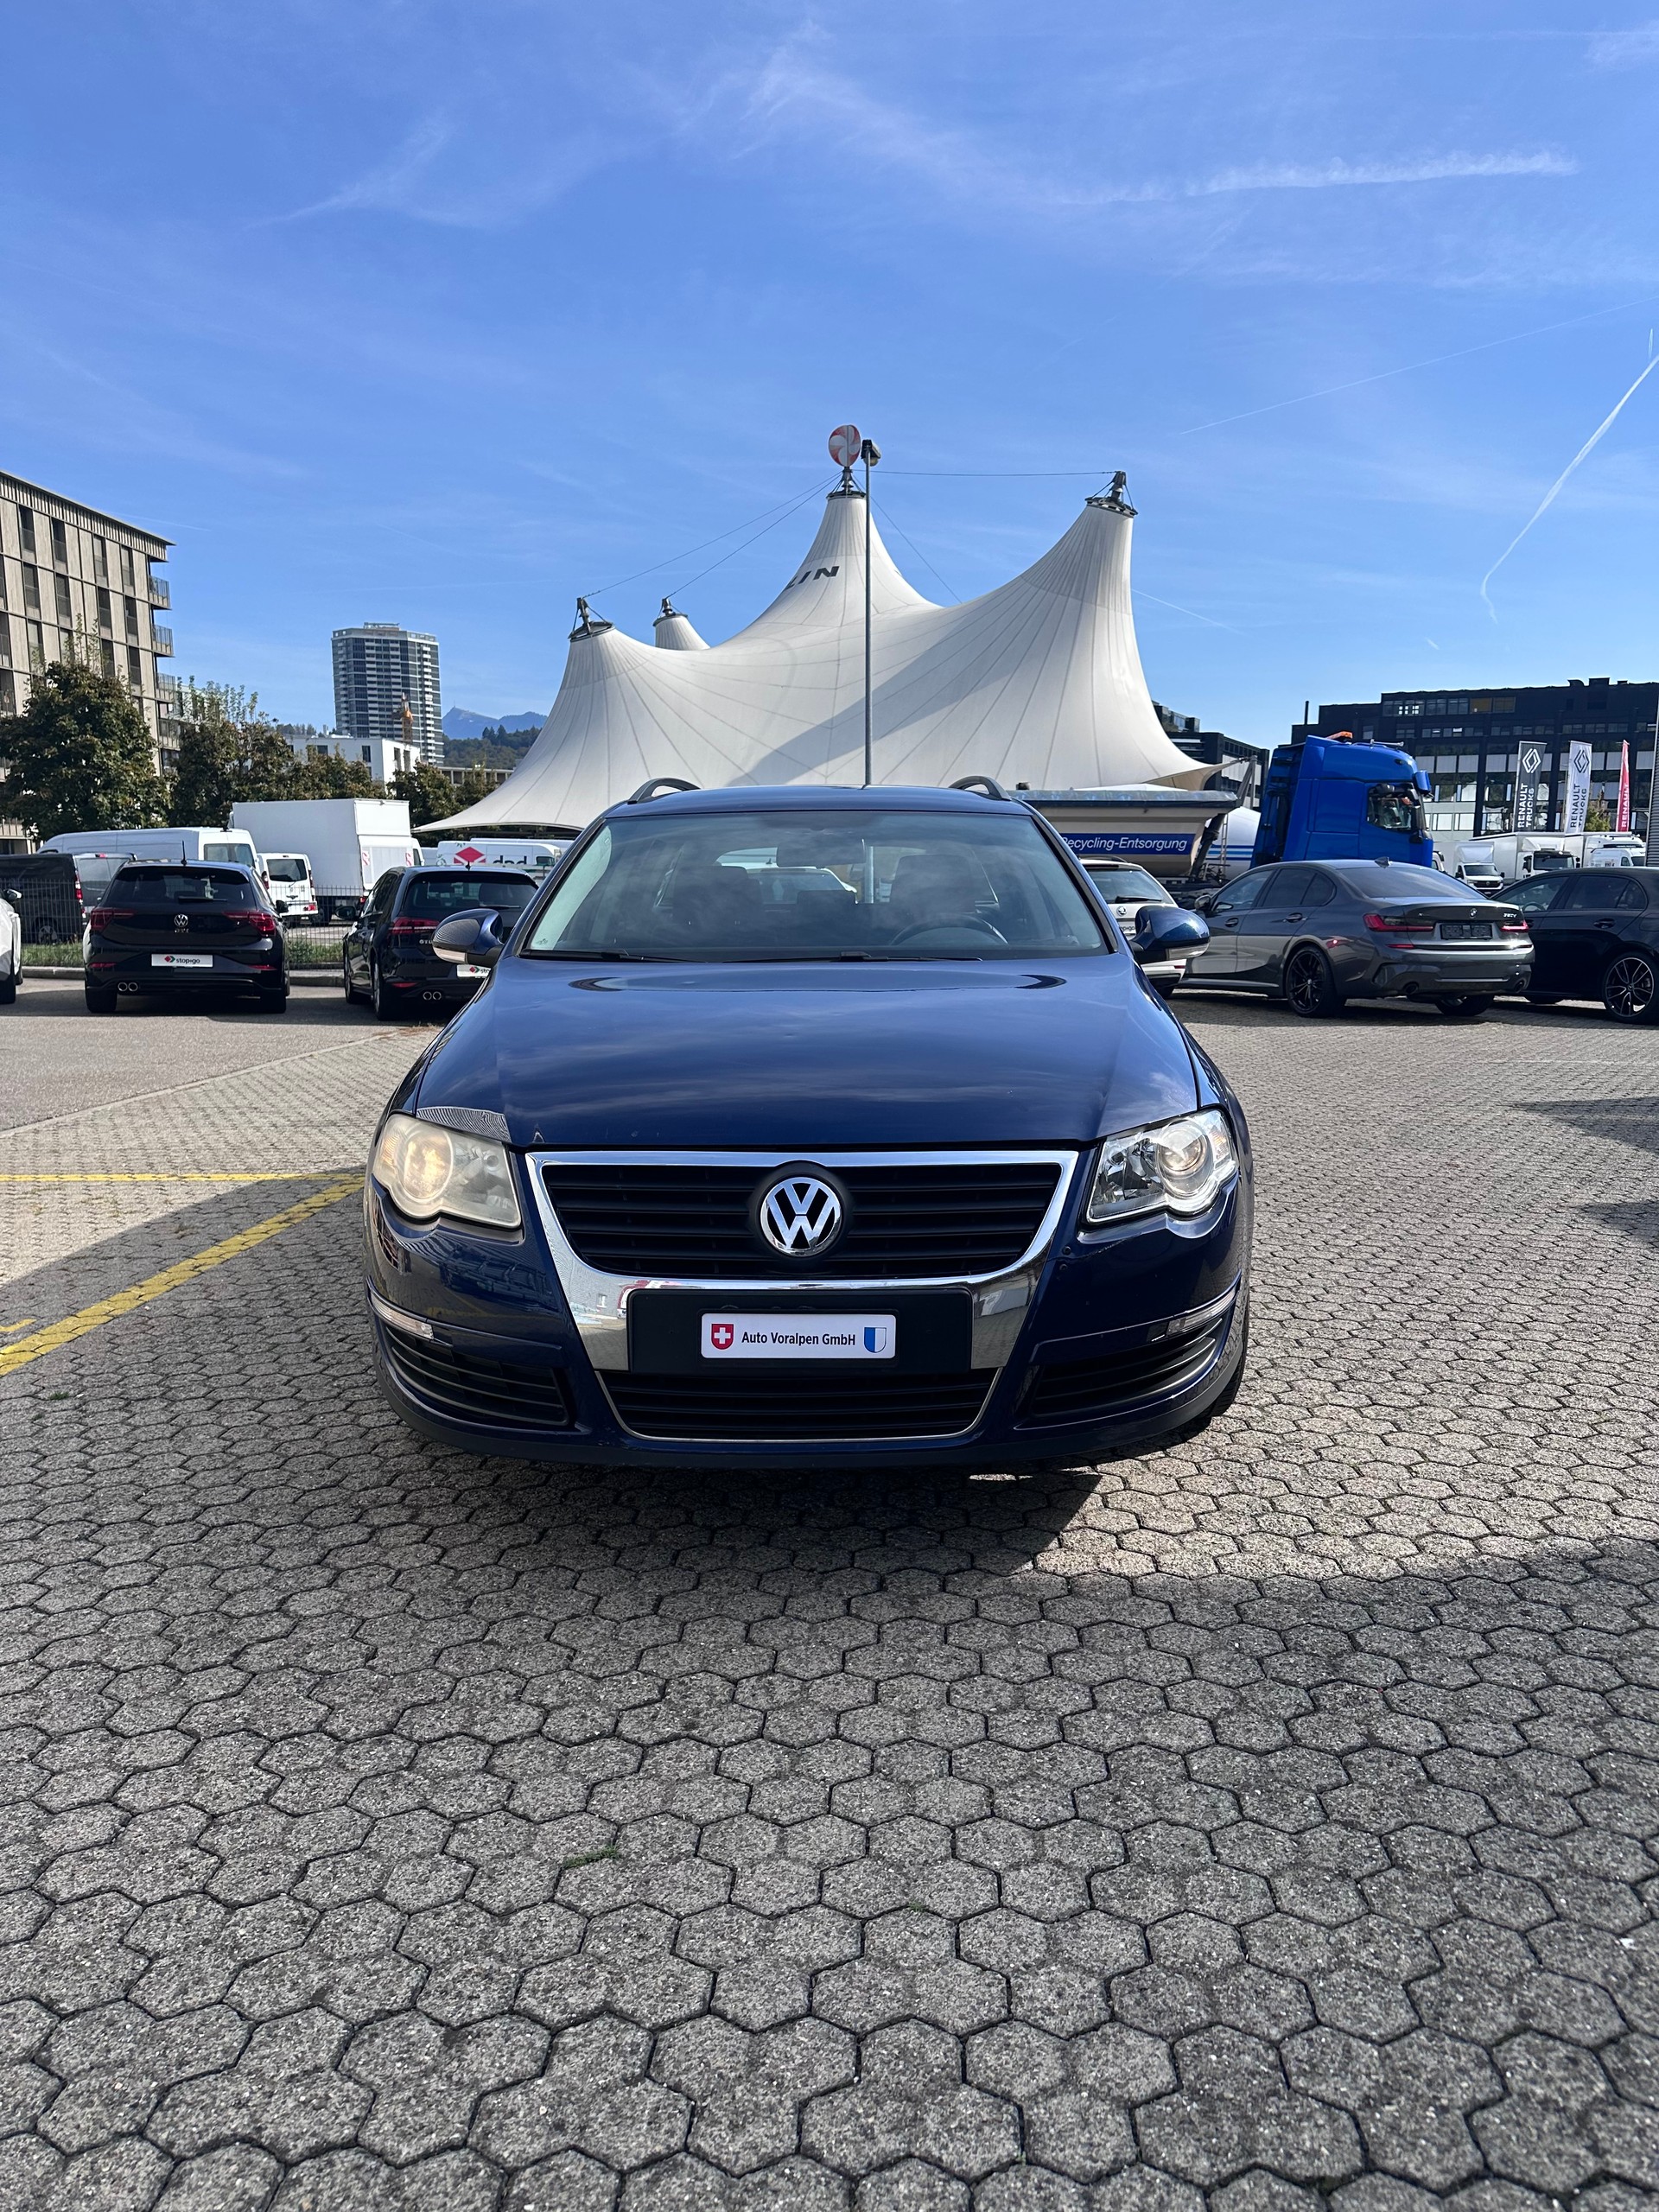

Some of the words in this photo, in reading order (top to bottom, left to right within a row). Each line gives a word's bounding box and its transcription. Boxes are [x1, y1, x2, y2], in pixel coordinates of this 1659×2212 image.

[1517, 783, 1529, 828] RENAULT
[1525, 787, 1535, 828] TRUCKS
[1570, 783, 1580, 828] RENAULT
[741, 1332, 767, 1344] Auto
[771, 1332, 819, 1346] Voralpen
[822, 1333, 855, 1345] GmbH
